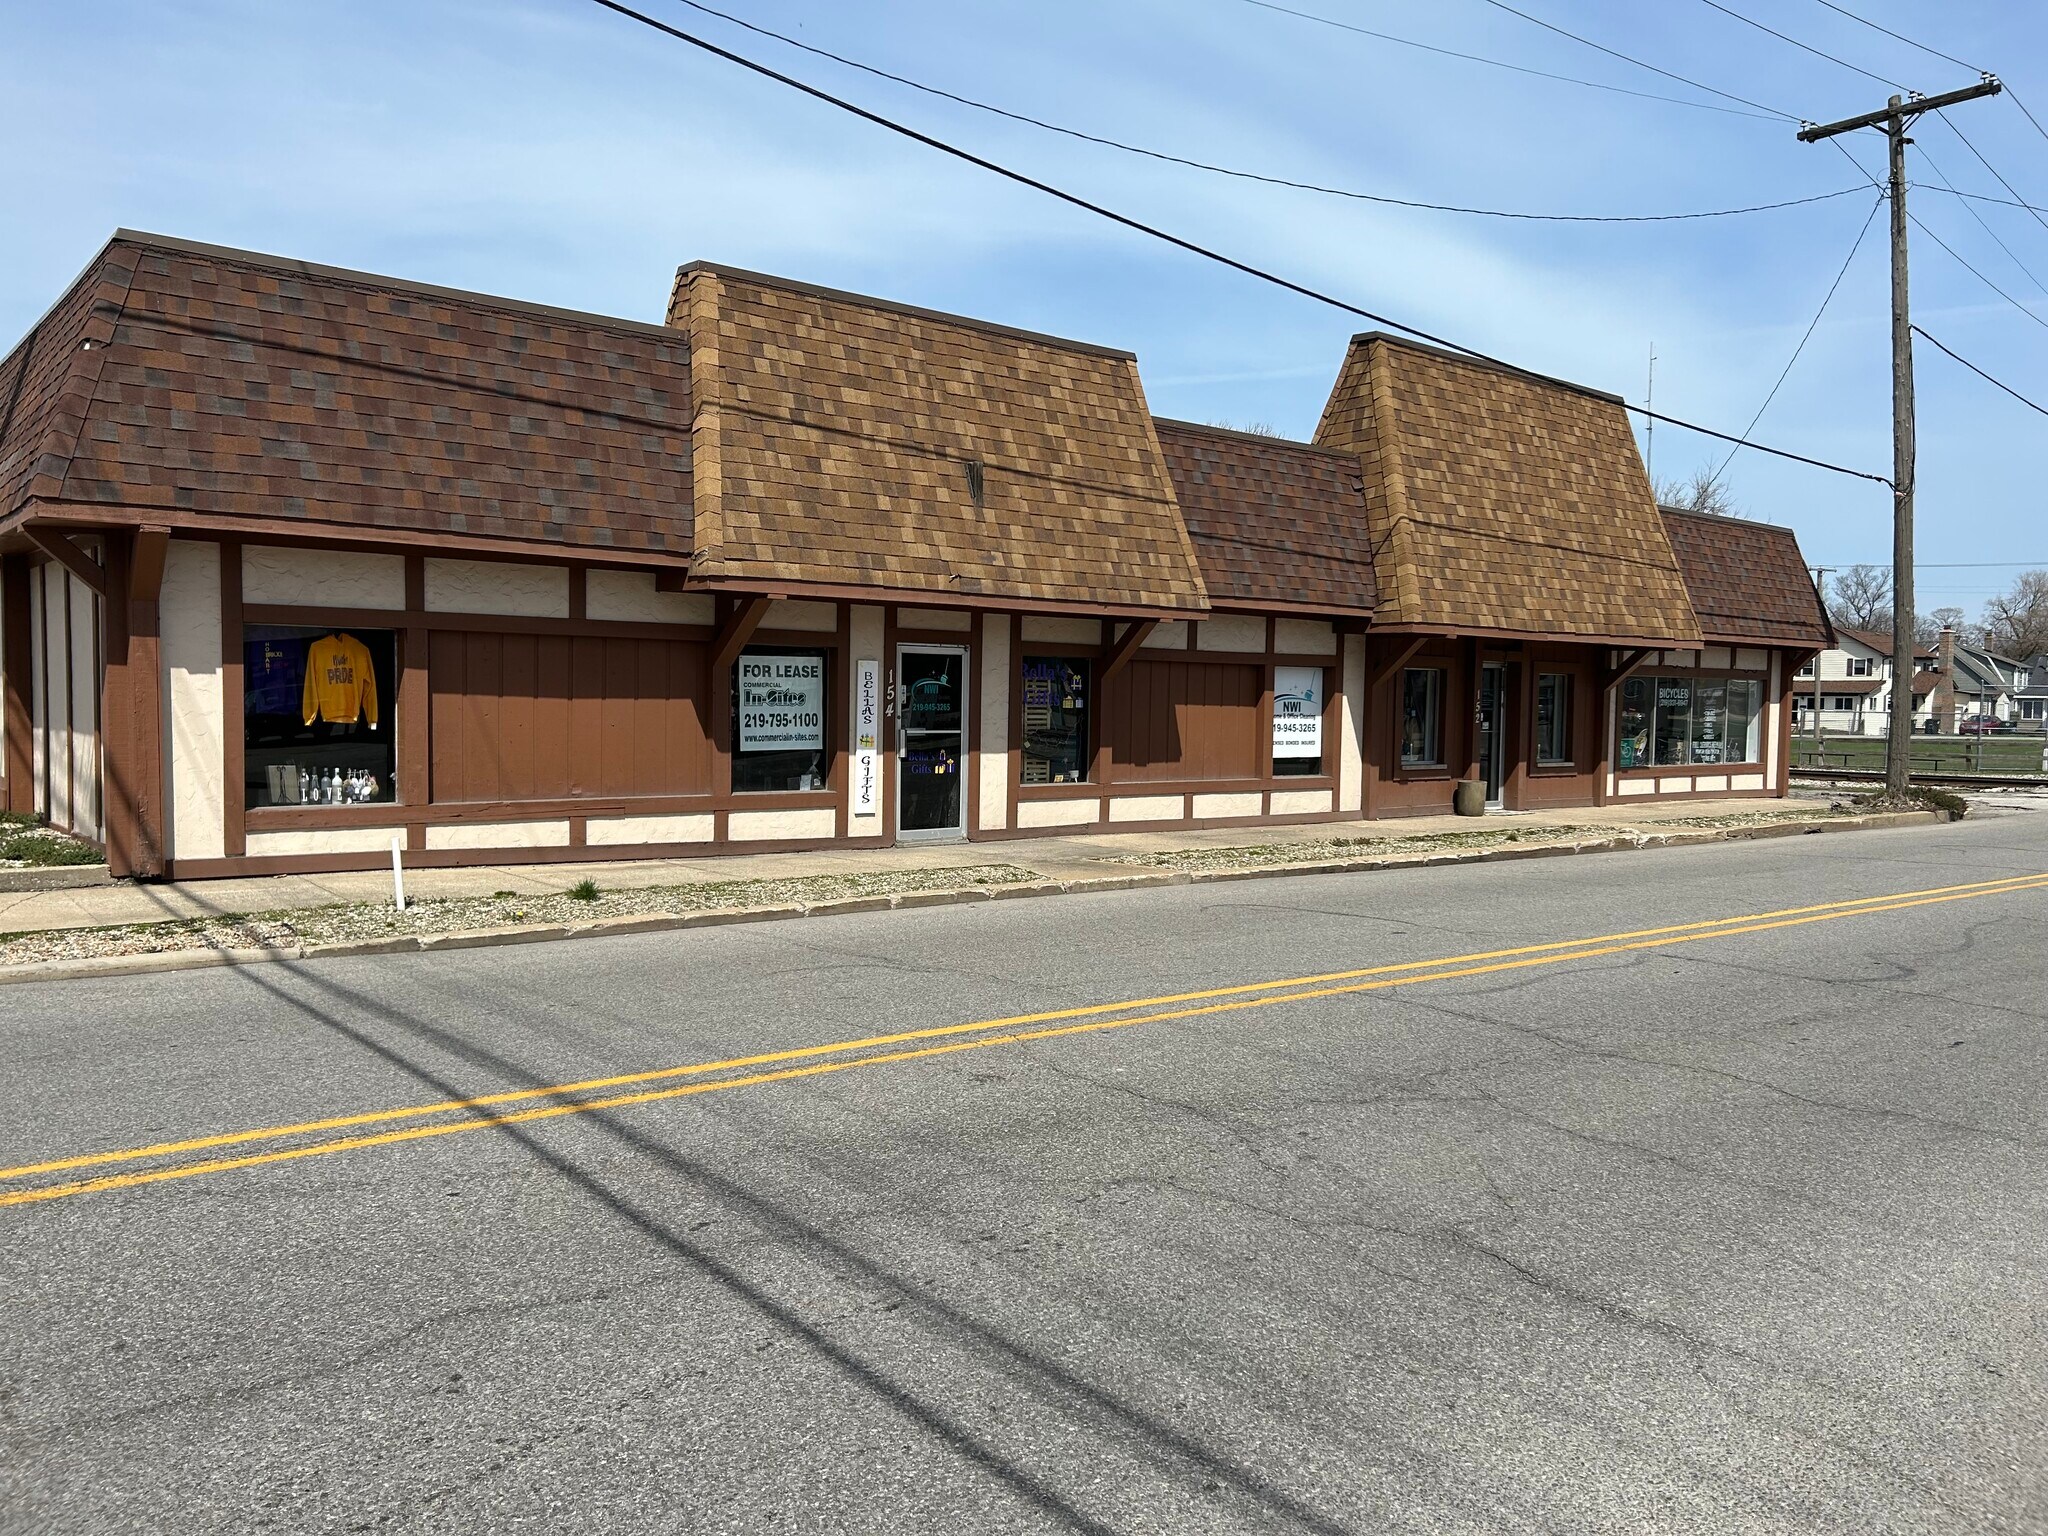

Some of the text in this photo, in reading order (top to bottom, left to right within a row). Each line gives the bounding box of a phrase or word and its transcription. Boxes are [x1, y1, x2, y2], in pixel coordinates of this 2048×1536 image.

[743, 664, 819, 678] FOR LEASE
[885, 669, 895, 717] 154
[924, 684, 939, 694] NWI
[1659, 687, 1689, 699] BICYCLES
[744, 688, 807, 707] In-Sites
[861, 671, 875, 725] BELLAS
[912, 703, 951, 711] 219-945-3265
[1283, 701, 1301, 712] NWI
[744, 713, 819, 728] 219-795-1100
[911, 764, 932, 774] Gifts
[302, 787, 343, 802] LOVE
